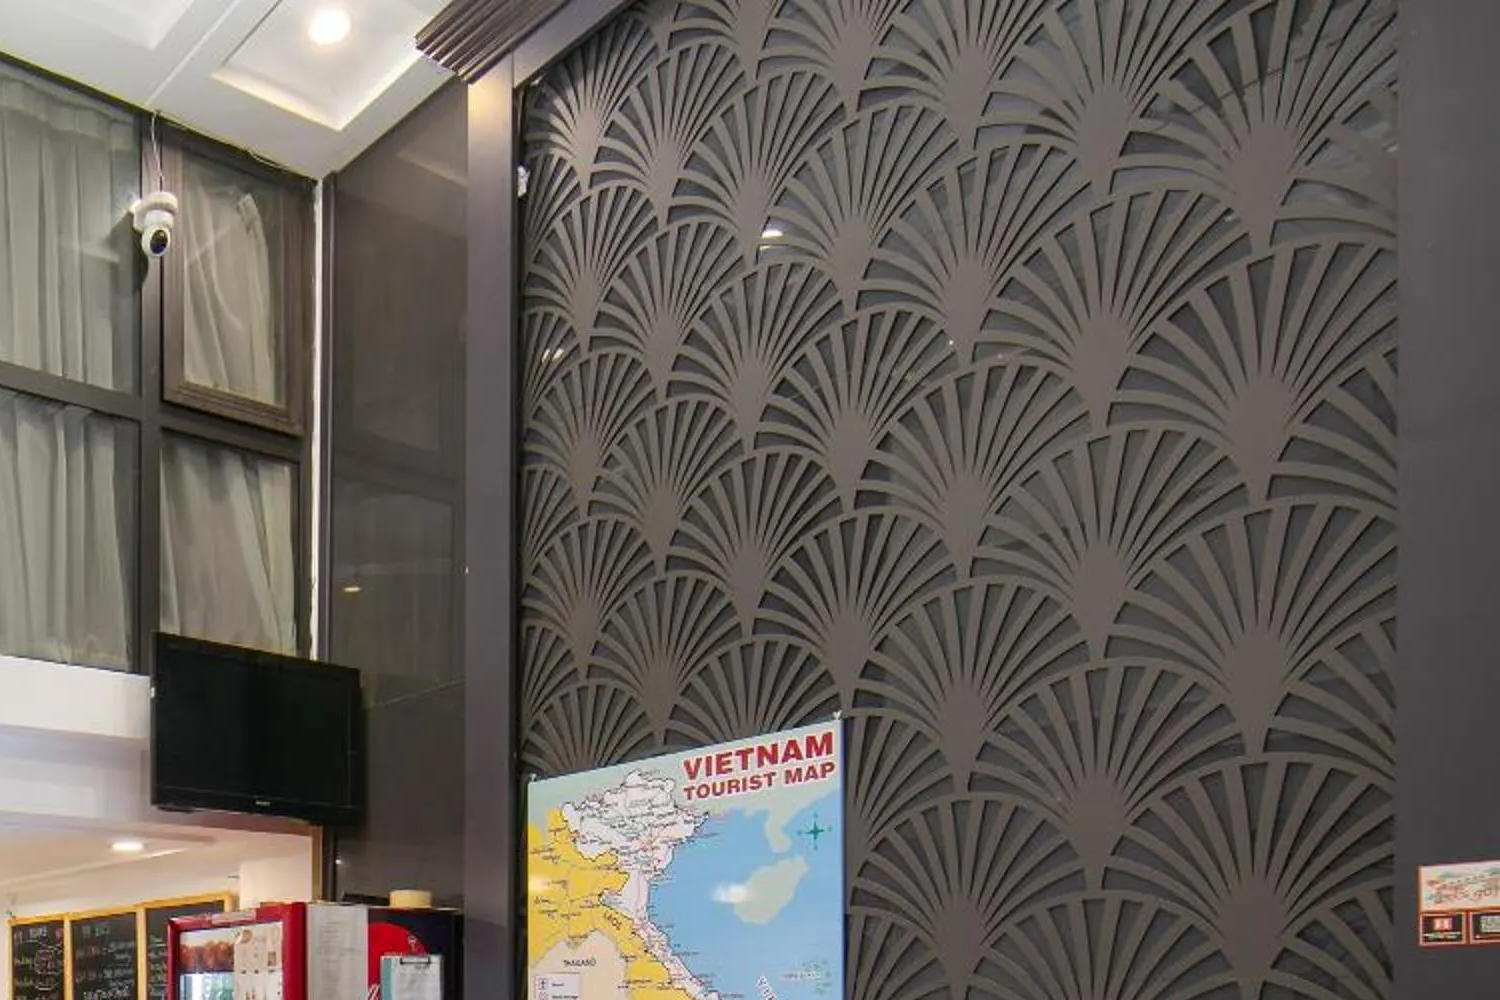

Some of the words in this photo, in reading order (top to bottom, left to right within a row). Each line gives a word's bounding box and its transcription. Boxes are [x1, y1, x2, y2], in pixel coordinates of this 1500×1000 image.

[683, 731, 834, 780] VIETNAM
[683, 771, 776, 800] TOURIST
[784, 761, 836, 785] MAP
